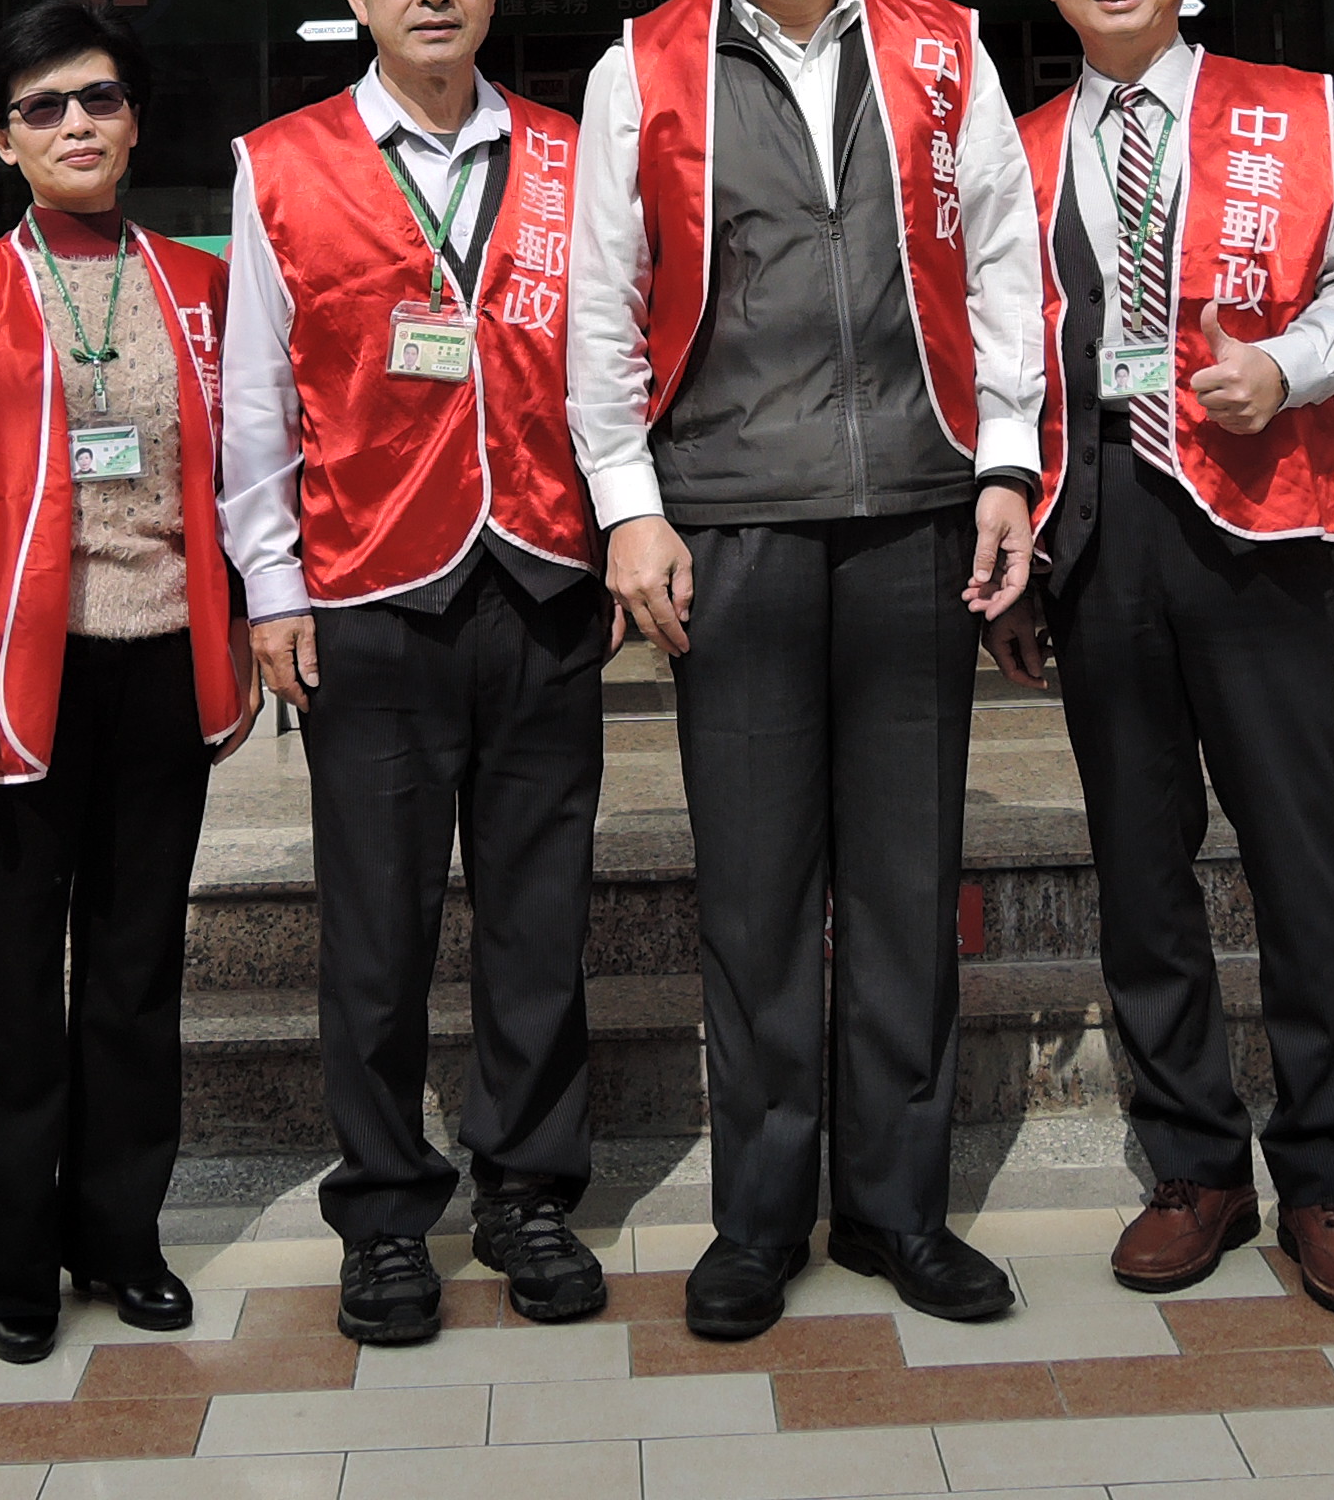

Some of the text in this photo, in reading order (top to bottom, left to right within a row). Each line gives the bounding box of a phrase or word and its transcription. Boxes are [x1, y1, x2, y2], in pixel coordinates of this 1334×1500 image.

[503, 126, 568, 338] 中華郵政
[1214, 105, 1289, 317] 中華郵政
